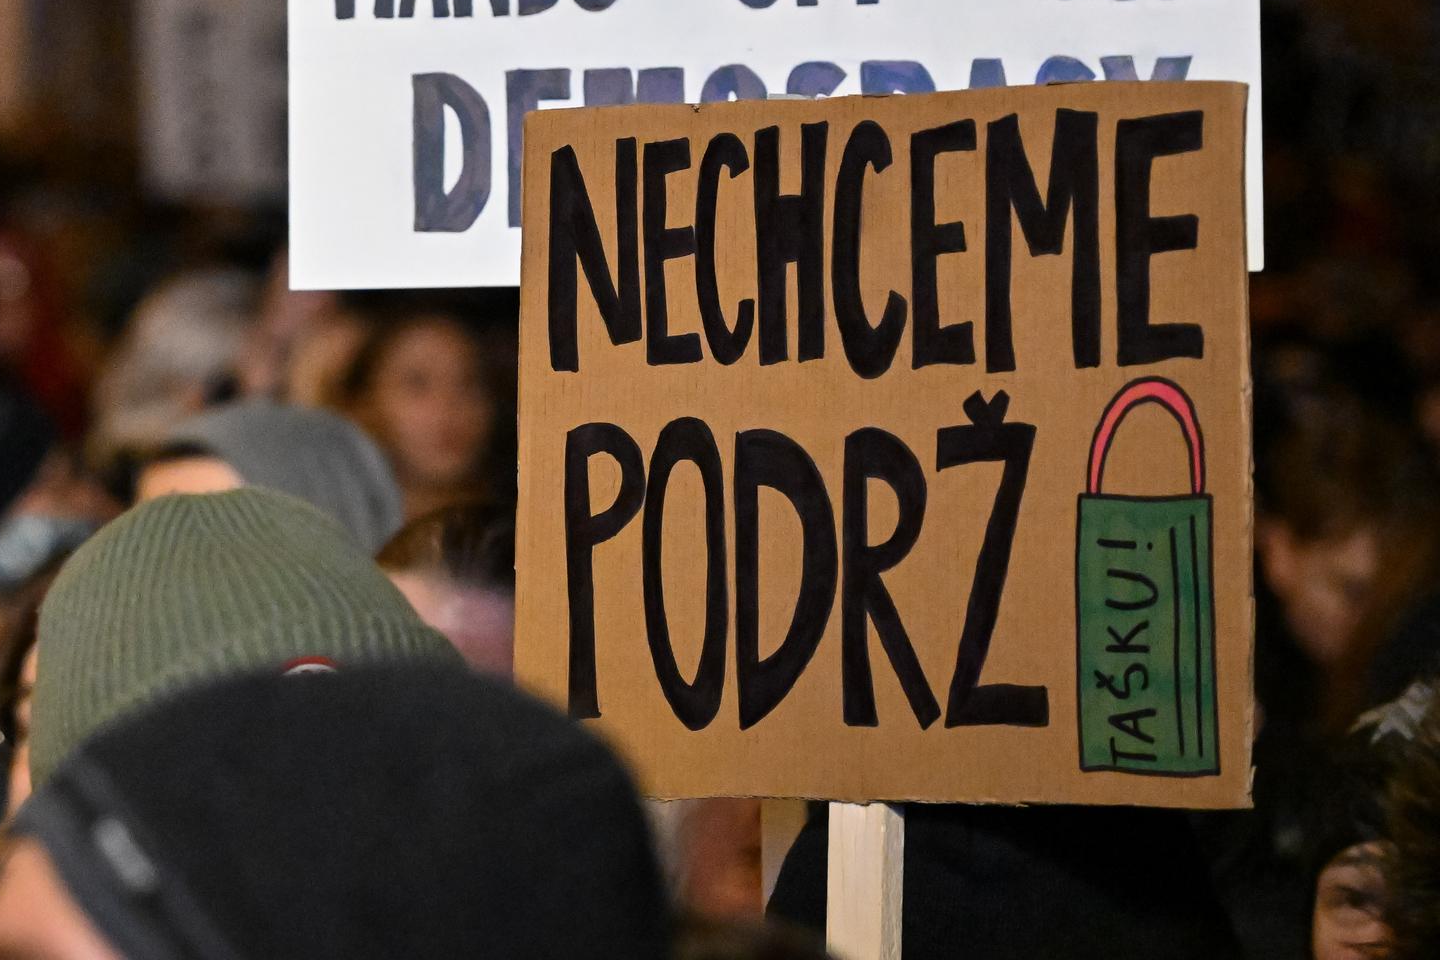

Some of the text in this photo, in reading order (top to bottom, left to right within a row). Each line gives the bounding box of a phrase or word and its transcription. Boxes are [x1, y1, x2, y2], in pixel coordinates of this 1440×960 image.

[547, 107, 1205, 379] NECHCEME
[564, 389, 1050, 732] PODRŽ
[1093, 538, 1159, 766] TAŠKU!
